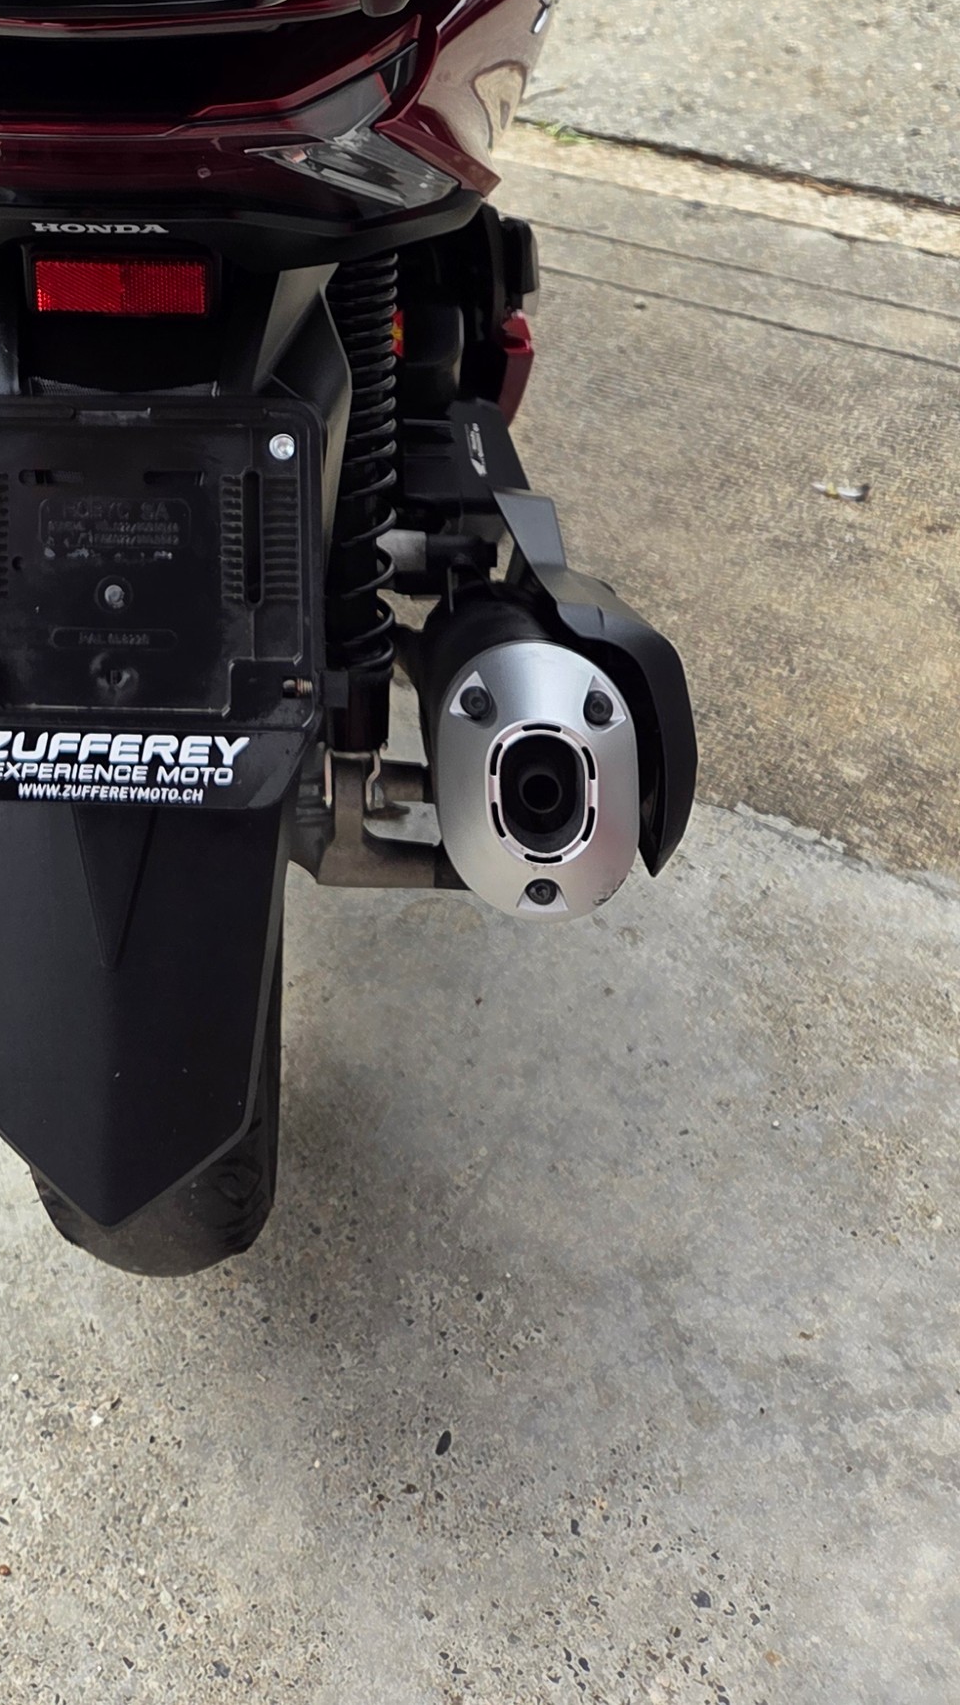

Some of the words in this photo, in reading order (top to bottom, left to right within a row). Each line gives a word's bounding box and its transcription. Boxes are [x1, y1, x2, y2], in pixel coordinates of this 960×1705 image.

[31, 222, 170, 234] HONDA
[156, 765, 234, 786] MOTO
[17, 782, 204, 804] WWW.ZUFFEREYMOTO.CH
